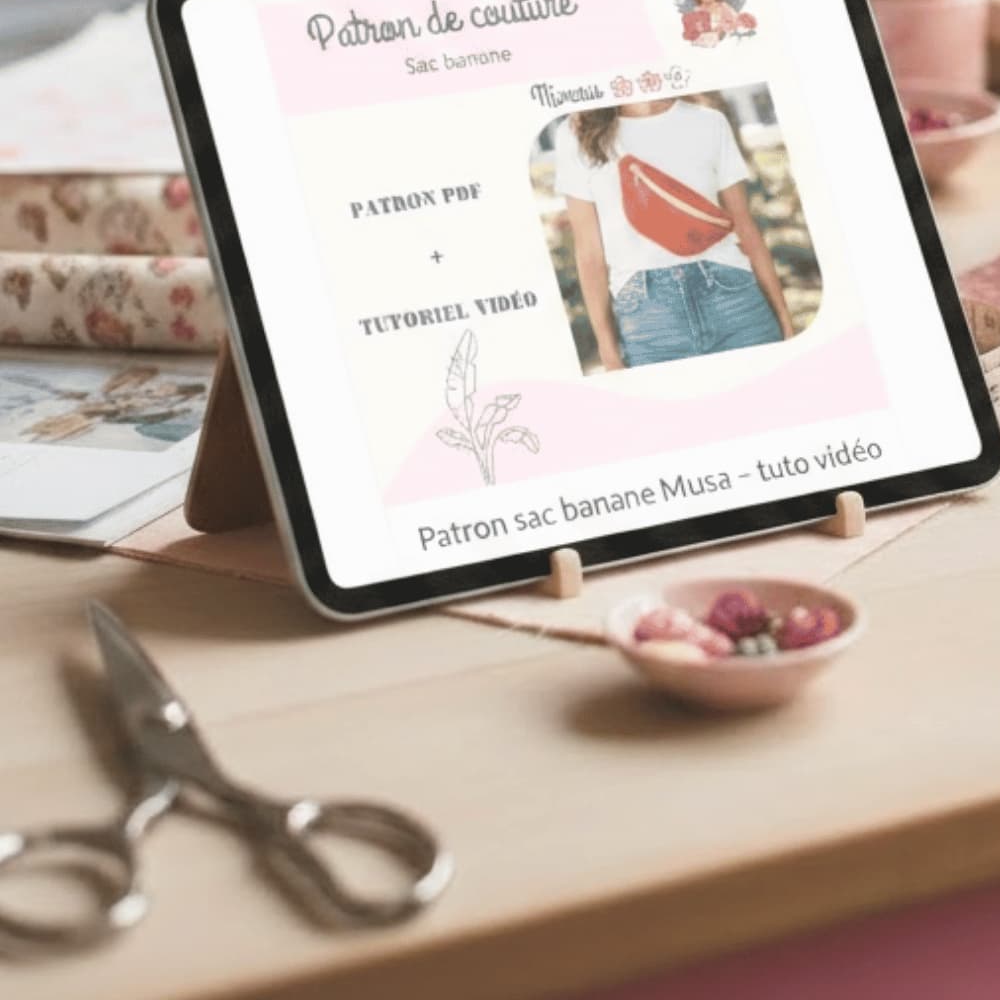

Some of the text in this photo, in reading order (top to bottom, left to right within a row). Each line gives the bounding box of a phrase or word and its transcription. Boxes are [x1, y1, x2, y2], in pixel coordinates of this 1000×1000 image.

[307, 9, 421, 51] Patron
[427, 0, 464, 35] de
[404, 56, 439, 75] Sac
[350, 182, 482, 219] PATRON PDF
[358, 289, 538, 336] TUTORIEL VIDÉO
[418, 518, 508, 551] Patron
[514, 508, 556, 531] sac
[560, 489, 656, 521] banane
[659, 473, 732, 502] Musa
[757, 456, 810, 482] tuto
[814, 437, 883, 470] vidéo
